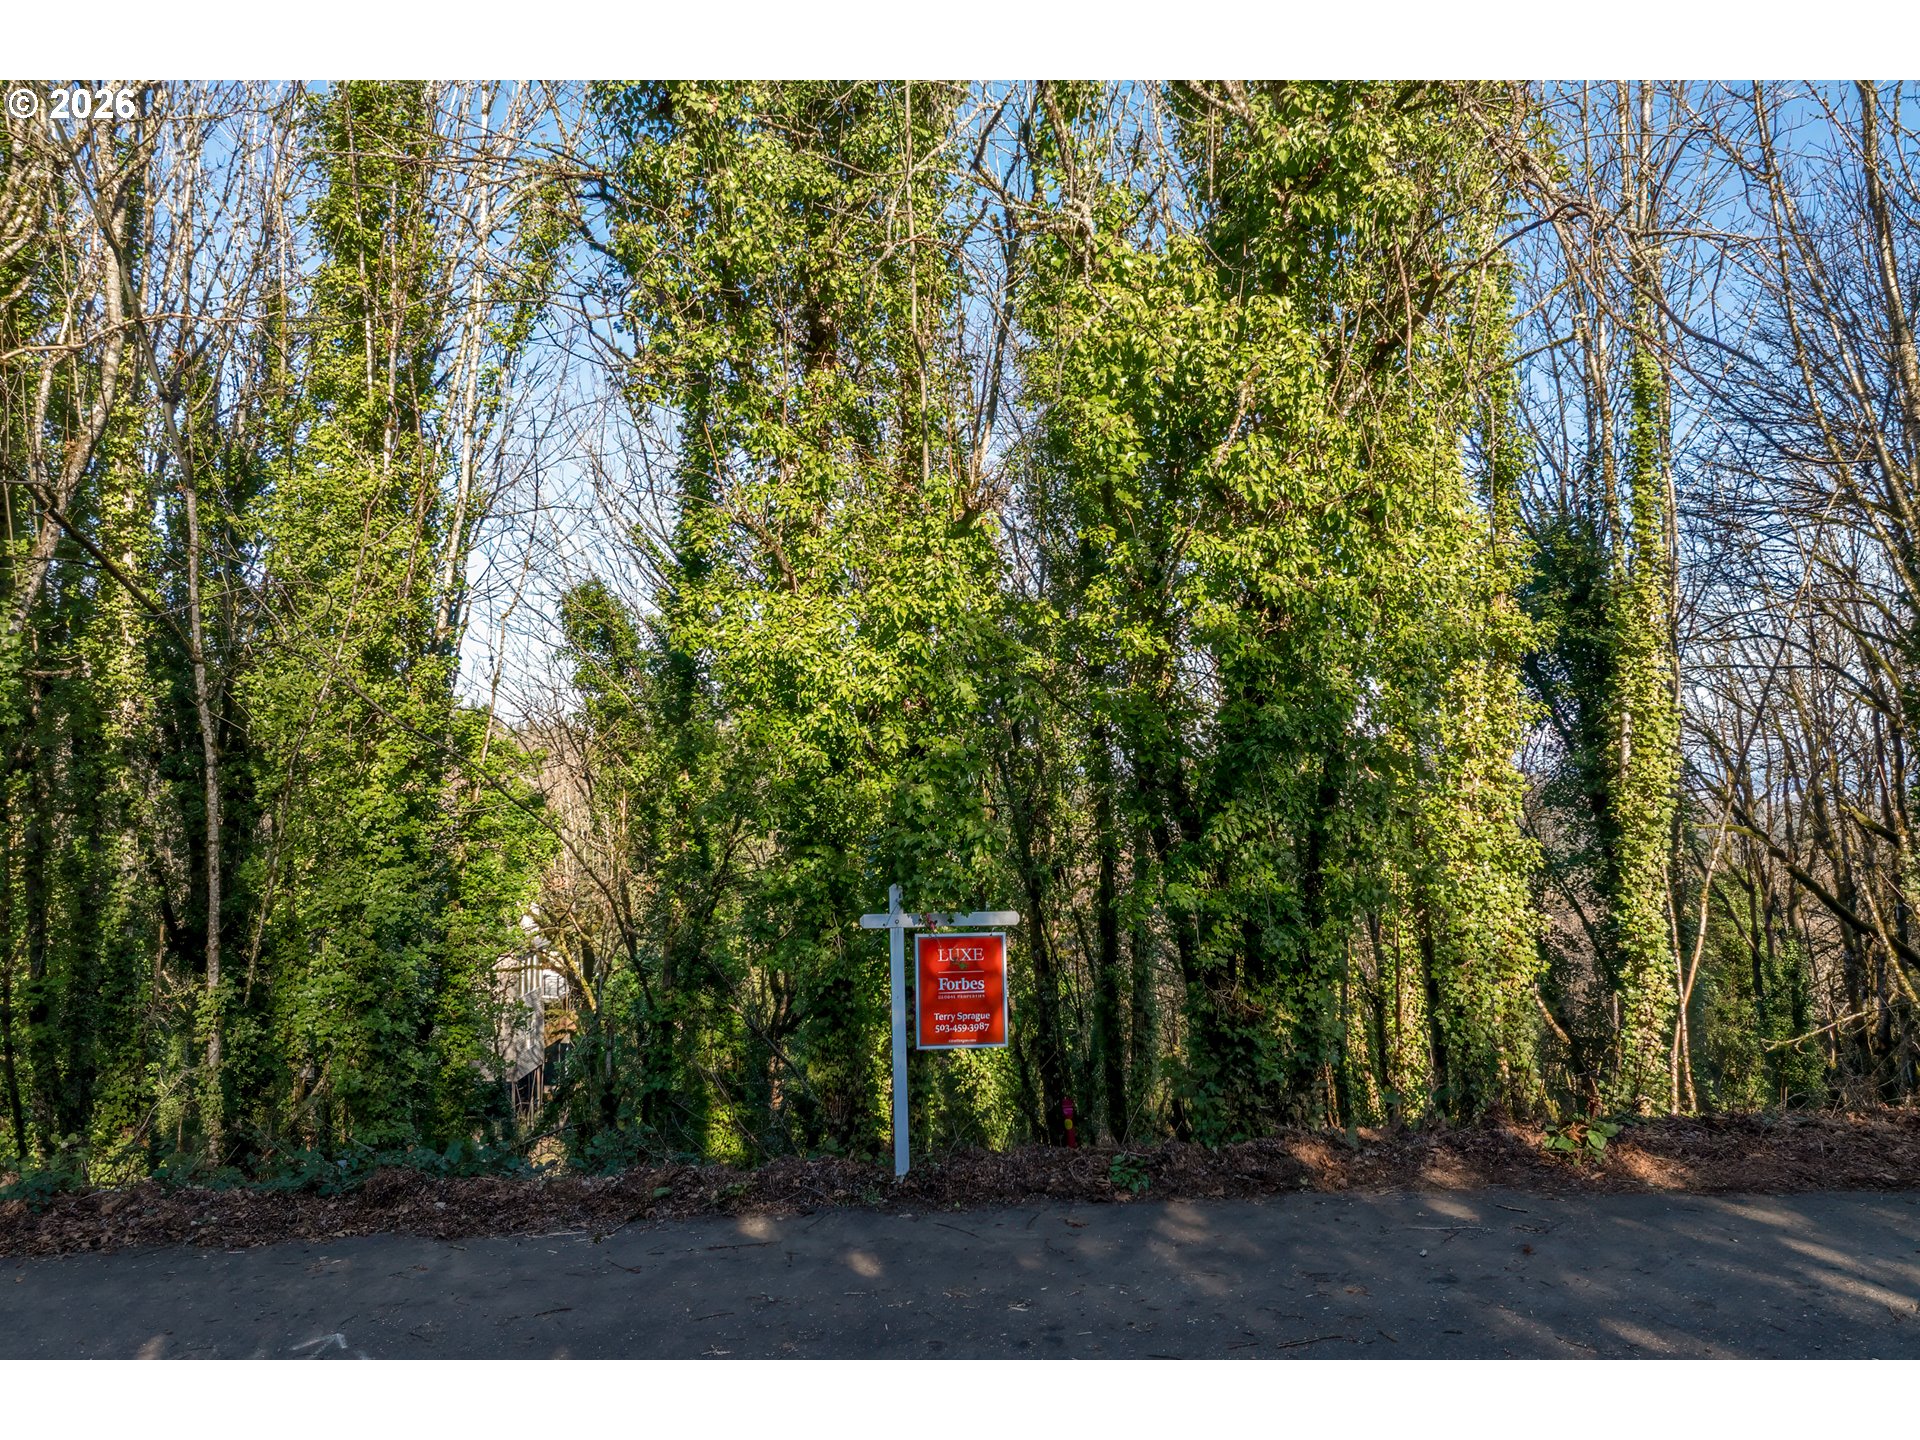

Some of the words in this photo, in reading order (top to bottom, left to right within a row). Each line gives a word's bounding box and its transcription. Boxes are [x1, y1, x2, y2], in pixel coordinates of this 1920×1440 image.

[938, 948, 984, 962] LUXE
[938, 977, 985, 991] Forbes
[934, 1012, 956, 1023] Terry
[957, 1012, 990, 1022] Sprague
